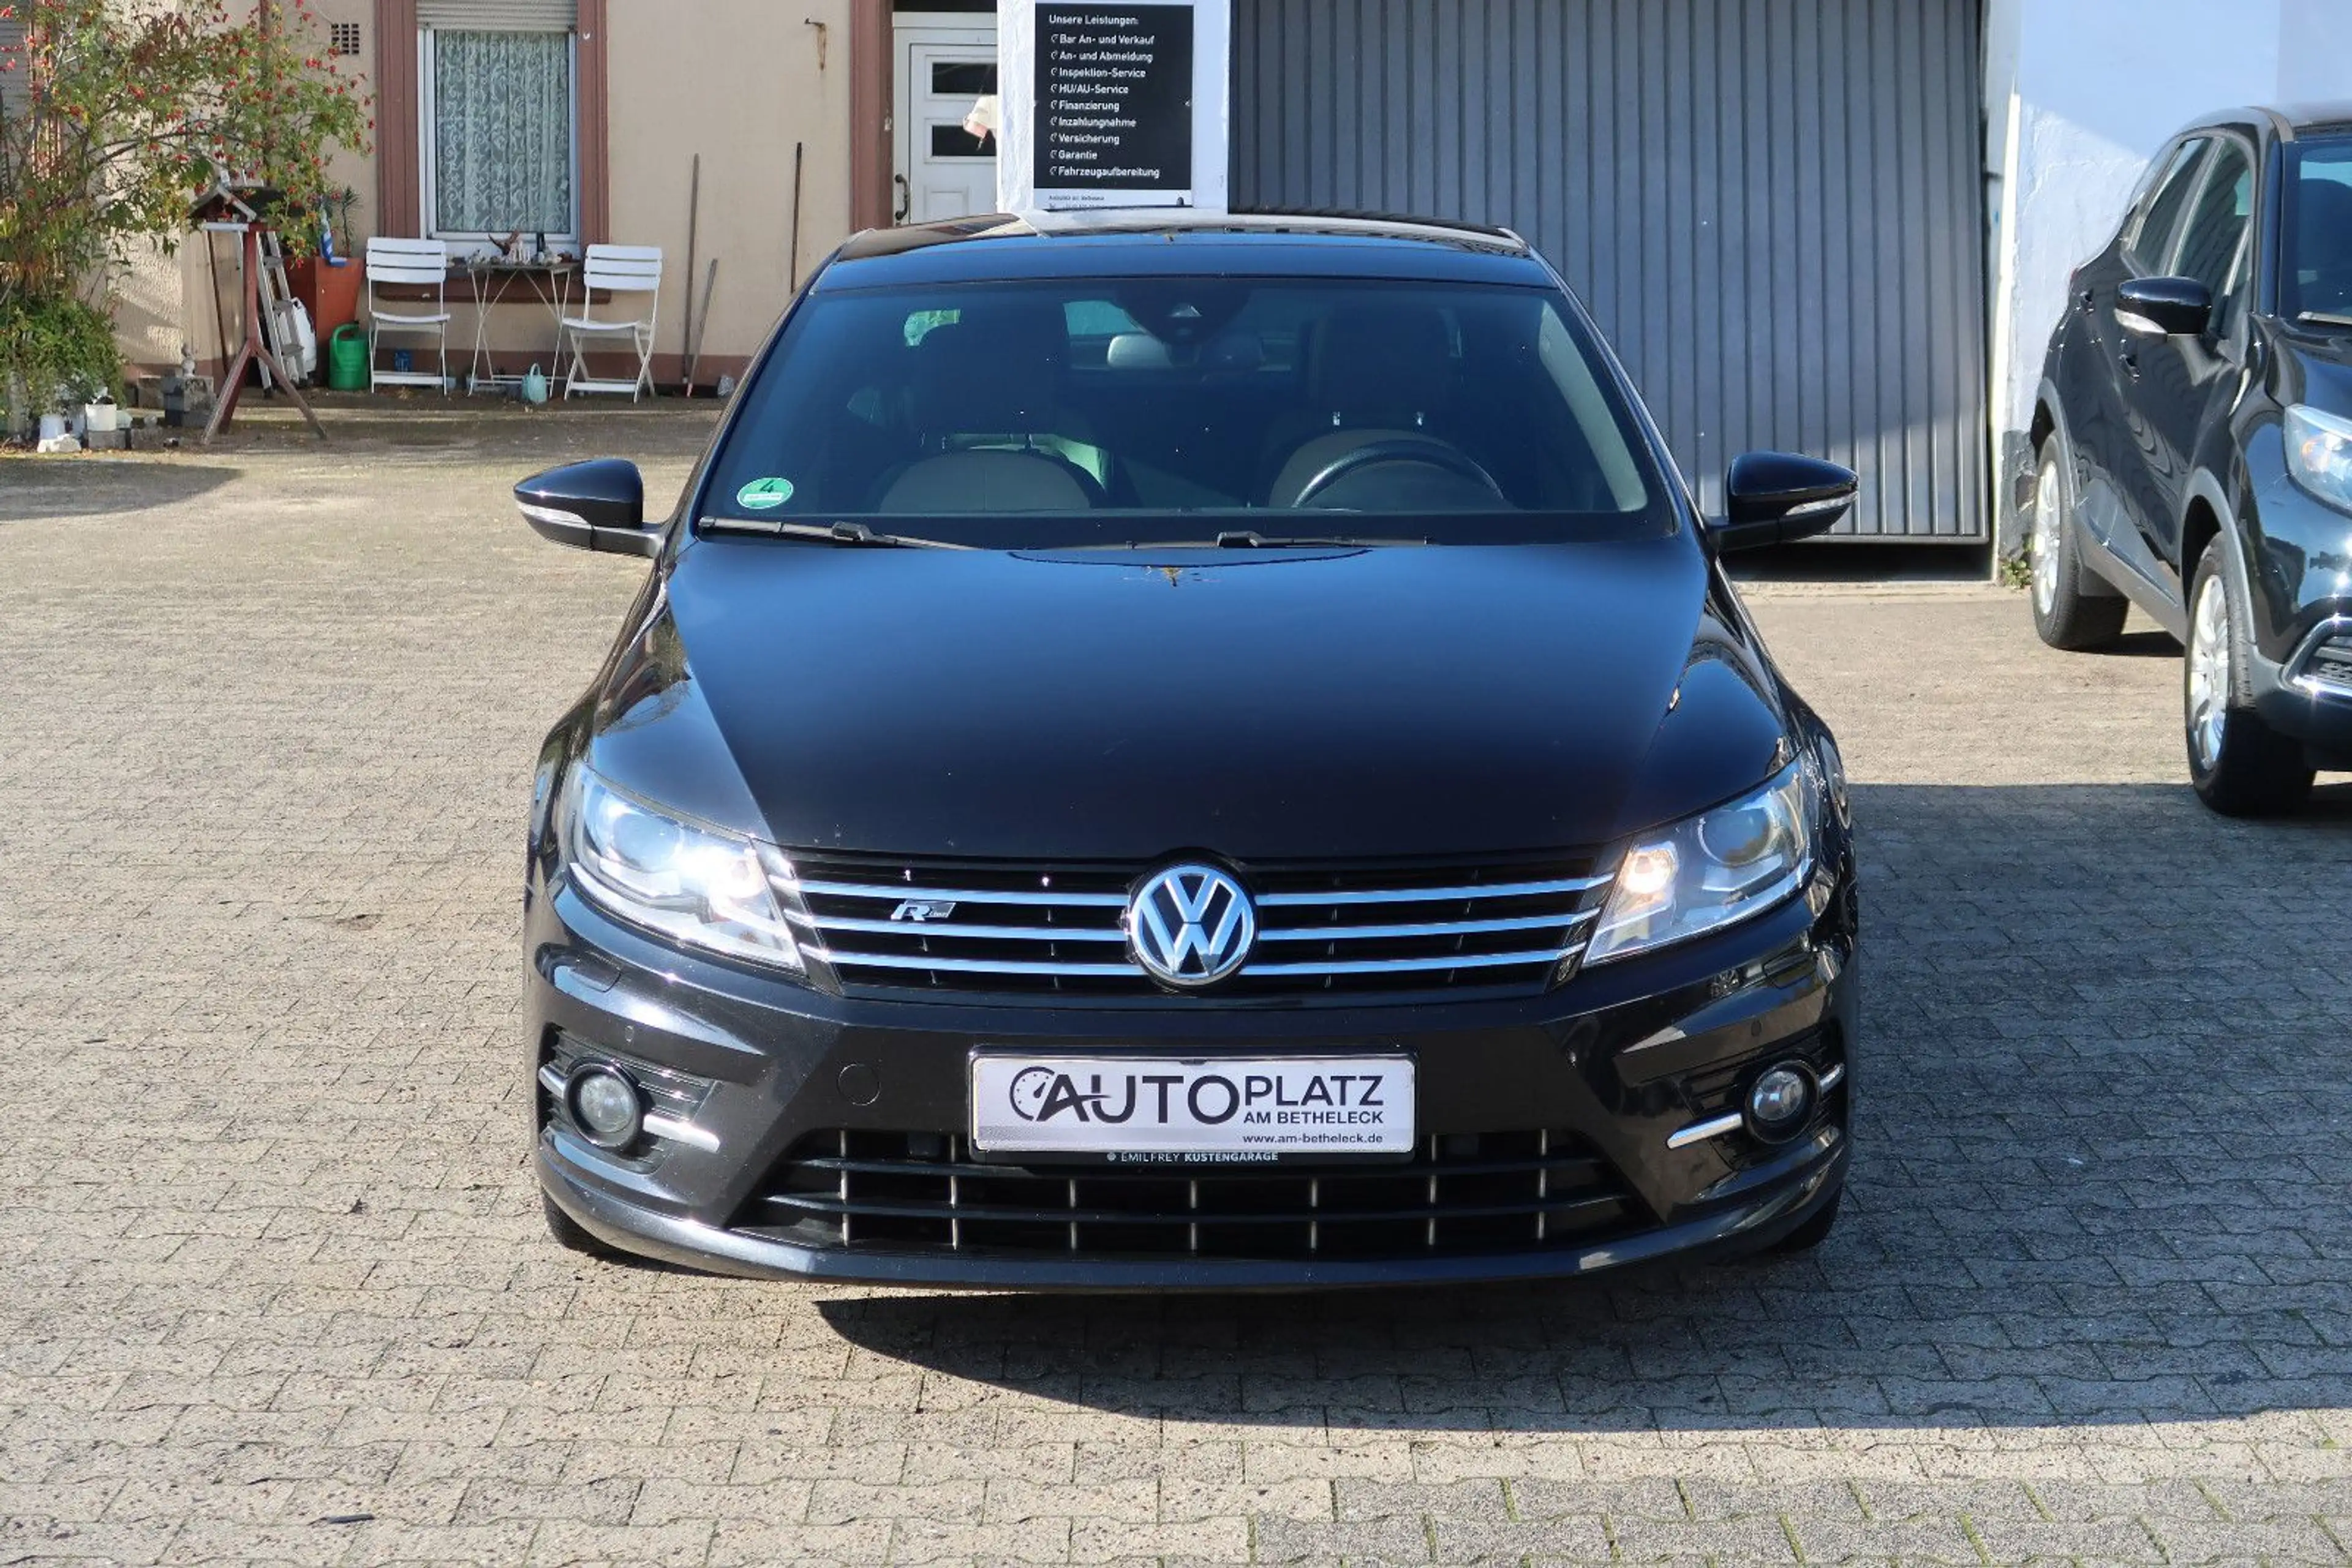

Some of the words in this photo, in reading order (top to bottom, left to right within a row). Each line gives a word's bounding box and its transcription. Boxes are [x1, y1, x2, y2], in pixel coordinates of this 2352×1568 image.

[1049, 15, 1082, 24] Unsere
[1060, 34, 1076, 43] Bar
[1079, 34, 1096, 43] An-
[1098, 35, 1117, 43] und
[1118, 35, 1155, 44] Verkauf
[1060, 50, 1077, 60] An-
[1079, 51, 1097, 60] und
[1099, 51, 1153, 64] Abmeldung
[1060, 67, 1146, 78] Inspektion-Service
[1059, 84, 1129, 93] HU/AU-Service
[1059, 100, 1119, 112] Finanzierung
[1058, 117, 1136, 129] Inzahlungnahme
[1058, 134, 1119, 145] Versicherung
[1058, 150, 1098, 159] Garantie
[1058, 166, 1159, 178] Fahrzeugaufbereitung
[760, 480, 774, 492] 4
[1135, 867, 1250, 981] VW
[1243, 1111, 1271, 1124] AM
[1277, 1111, 1384, 1124] BETHELECK
[1243, 1133, 1383, 1143] www.am-betheleck.de
